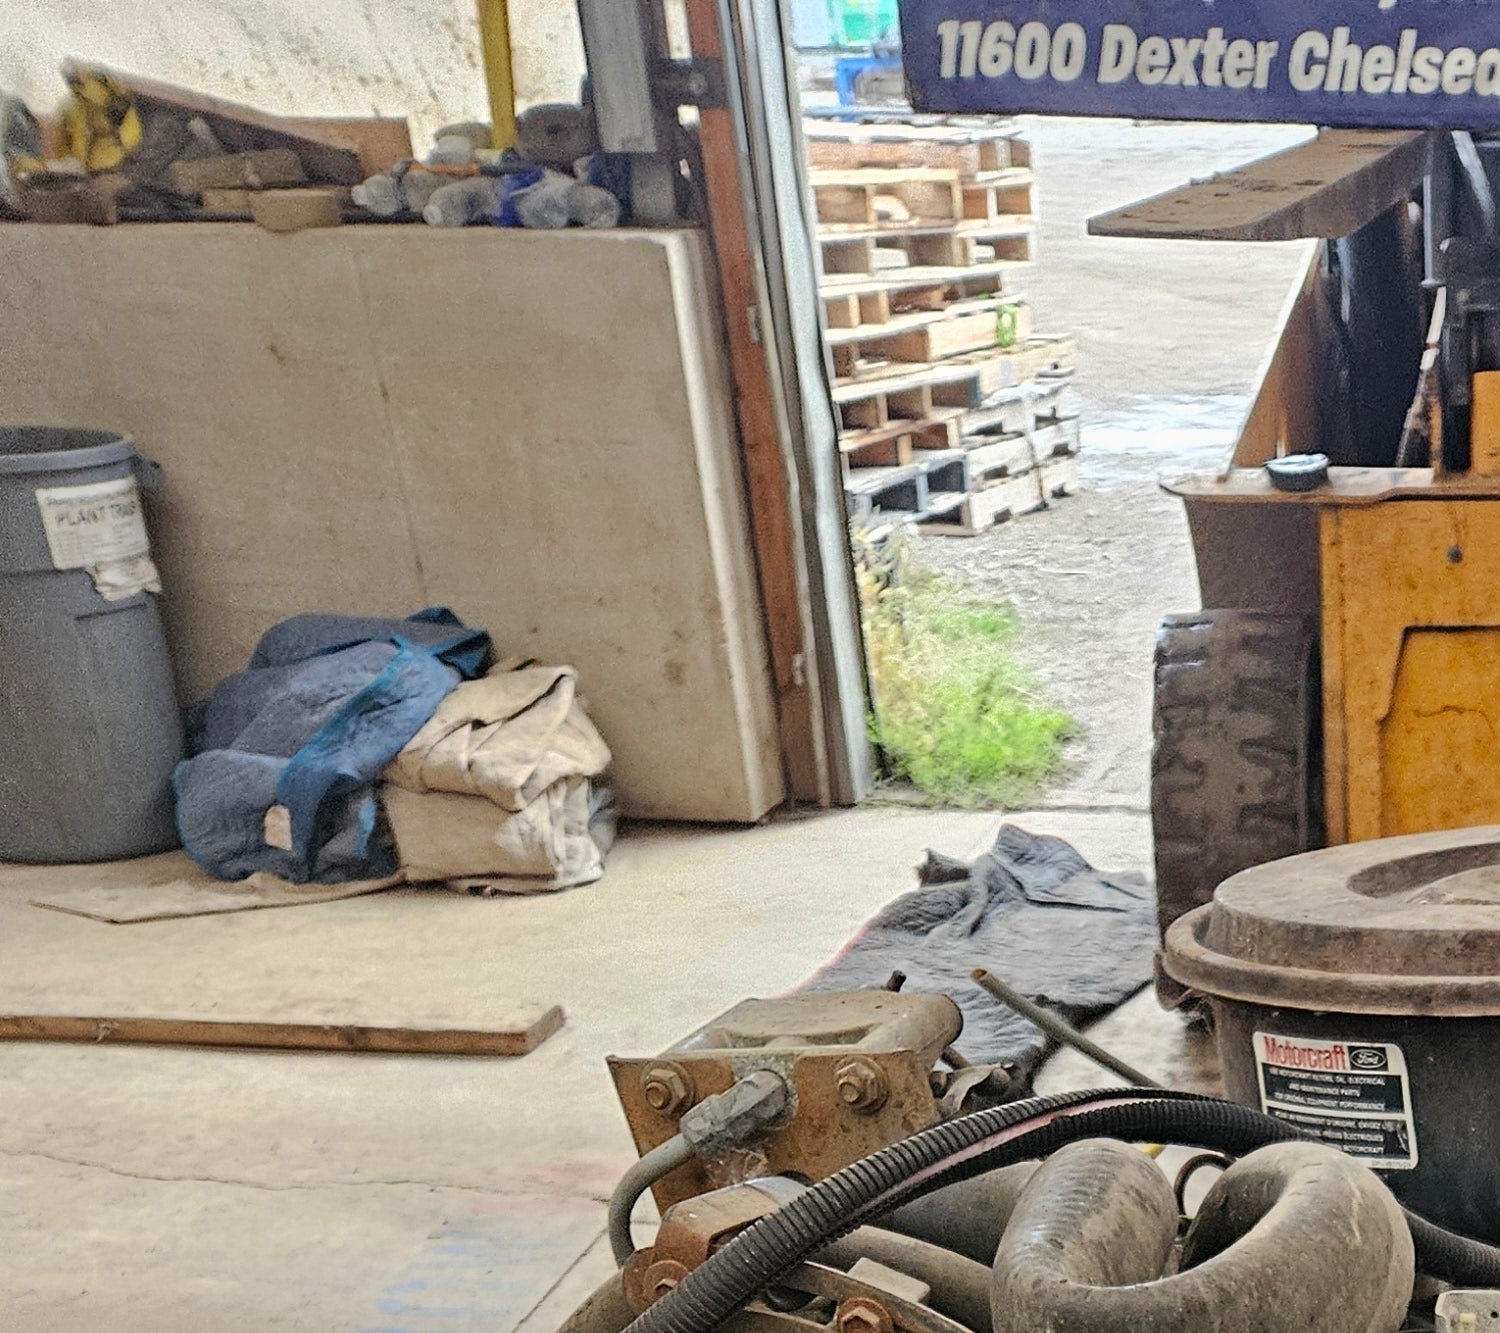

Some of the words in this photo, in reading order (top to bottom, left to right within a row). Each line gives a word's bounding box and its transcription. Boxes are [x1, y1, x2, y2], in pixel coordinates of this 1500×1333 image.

[937, 20, 1087, 82] 11600
[1097, 24, 1278, 90] Dexter
[1264, 1036, 1348, 1071] Motorcraft
